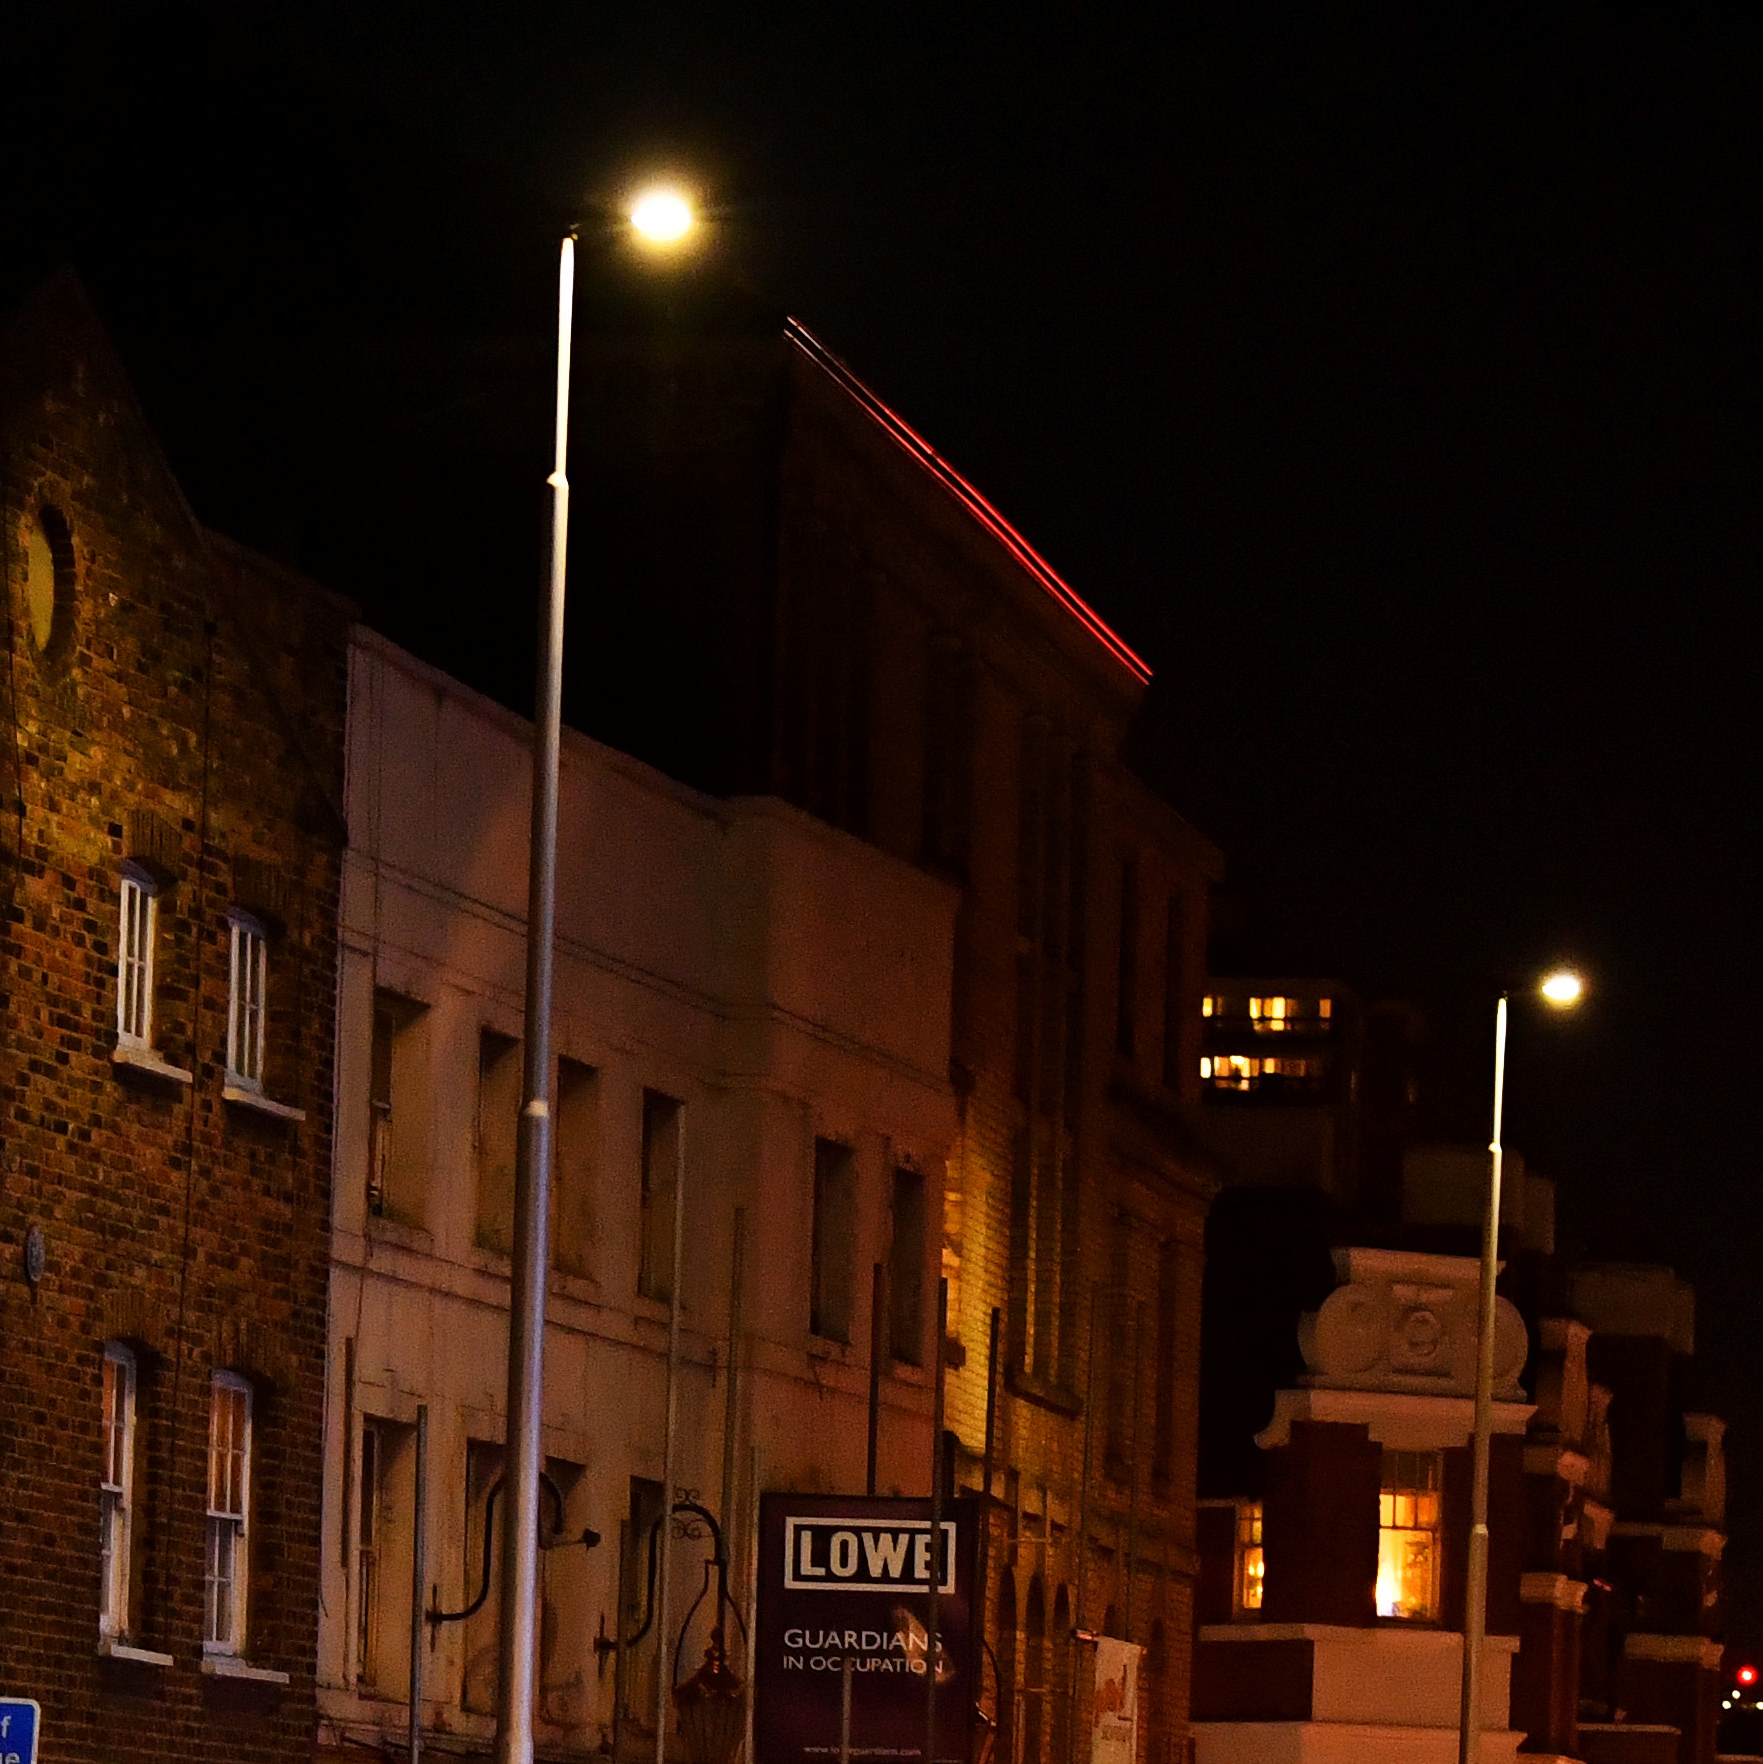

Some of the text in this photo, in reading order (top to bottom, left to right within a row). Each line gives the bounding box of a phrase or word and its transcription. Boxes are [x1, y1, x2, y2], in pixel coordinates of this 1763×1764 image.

[800, 1529, 941, 1580] LOWE
[783, 1628, 944, 1653] GUARDIANS
[783, 1655, 804, 1671] IN
